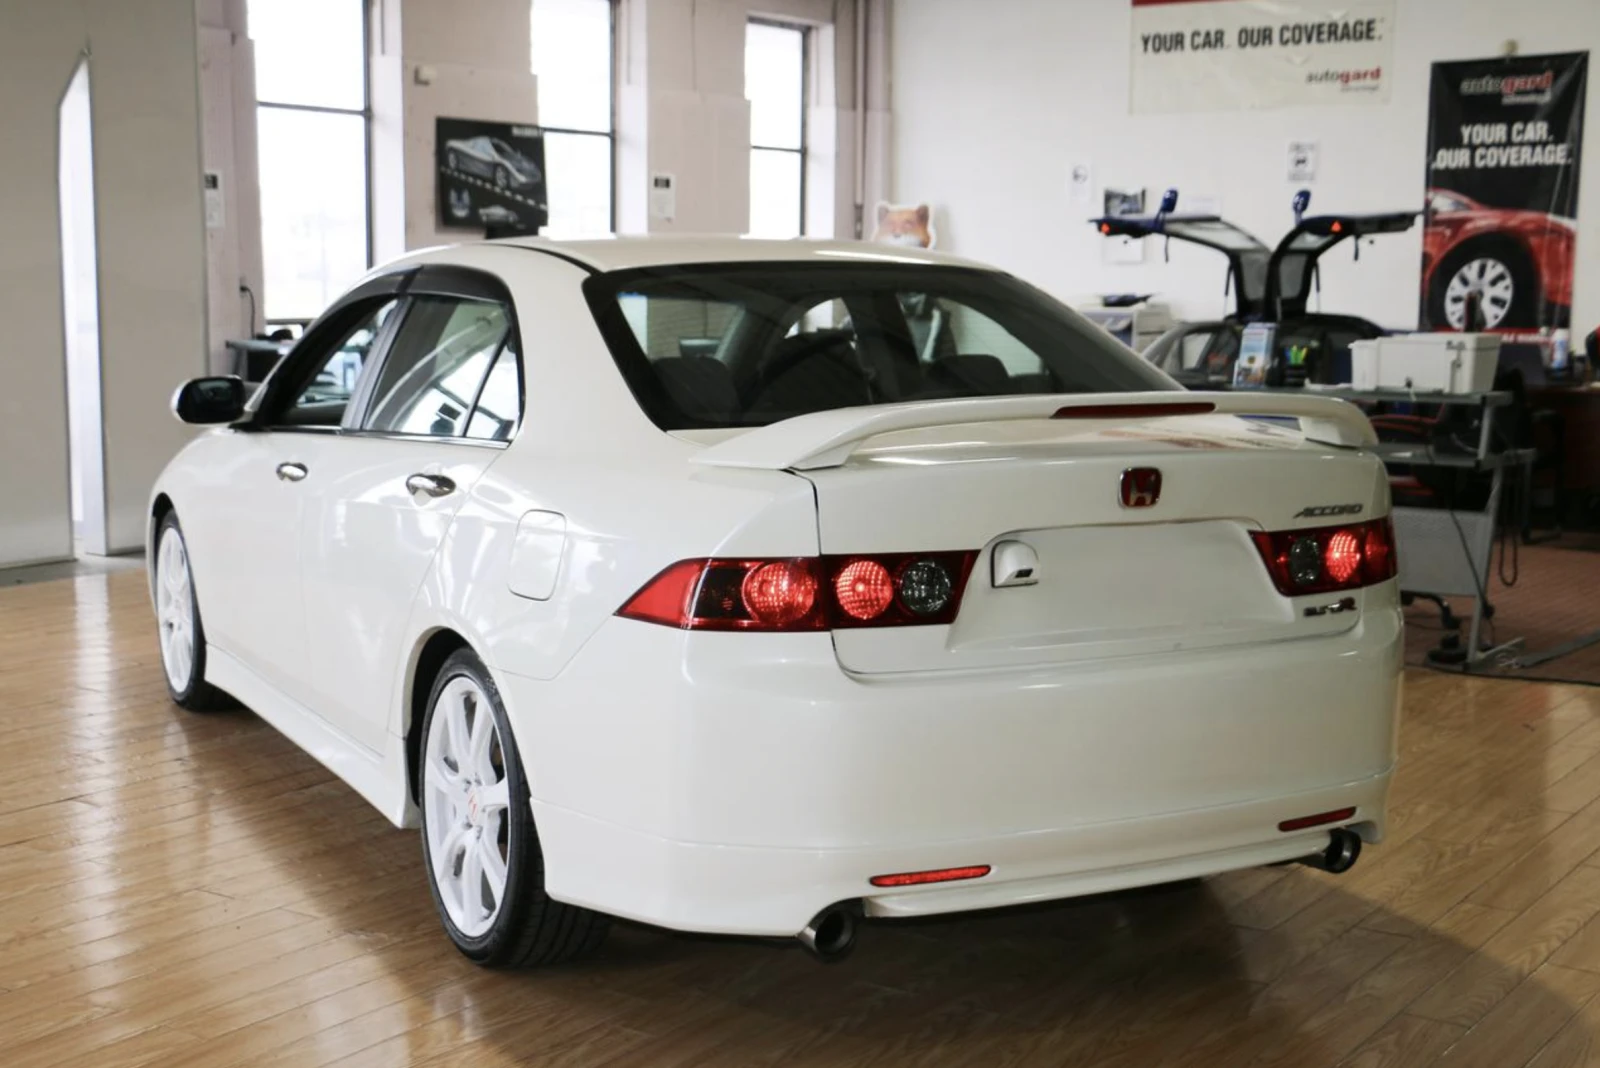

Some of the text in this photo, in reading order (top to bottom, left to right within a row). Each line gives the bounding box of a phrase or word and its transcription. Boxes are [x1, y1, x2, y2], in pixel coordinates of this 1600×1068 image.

[1141, 31, 1185, 53] YOUR
[1238, 26, 1273, 48] OUR
[1461, 120, 1553, 144] YOUR CAR.
[1474, 143, 1572, 168] COVERAGE.
